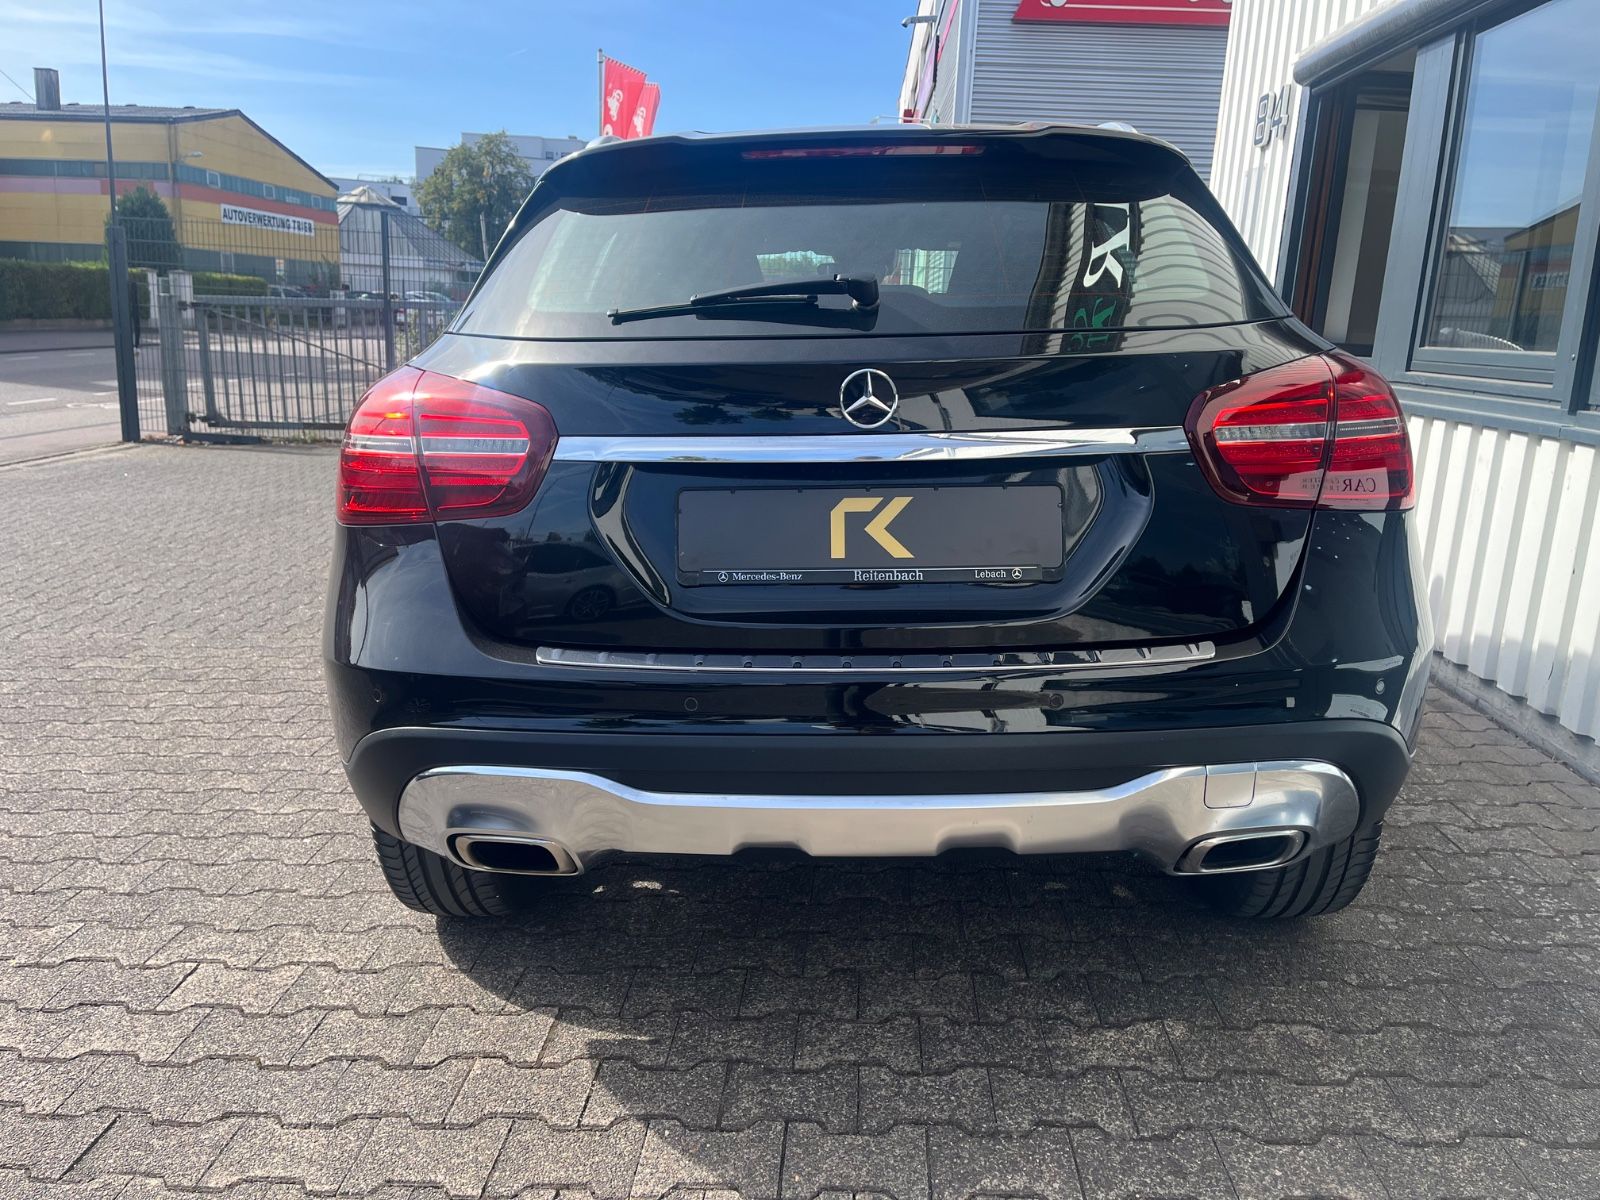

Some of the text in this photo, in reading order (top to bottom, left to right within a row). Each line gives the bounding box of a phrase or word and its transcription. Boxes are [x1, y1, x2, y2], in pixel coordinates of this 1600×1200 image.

[1253, 84, 1291, 148] 84
[222, 207, 313, 234] AUTOVERWERTUNG TRIER
[732, 568, 1006, 582] Mercedes-Benz Reitenbach Lebach
